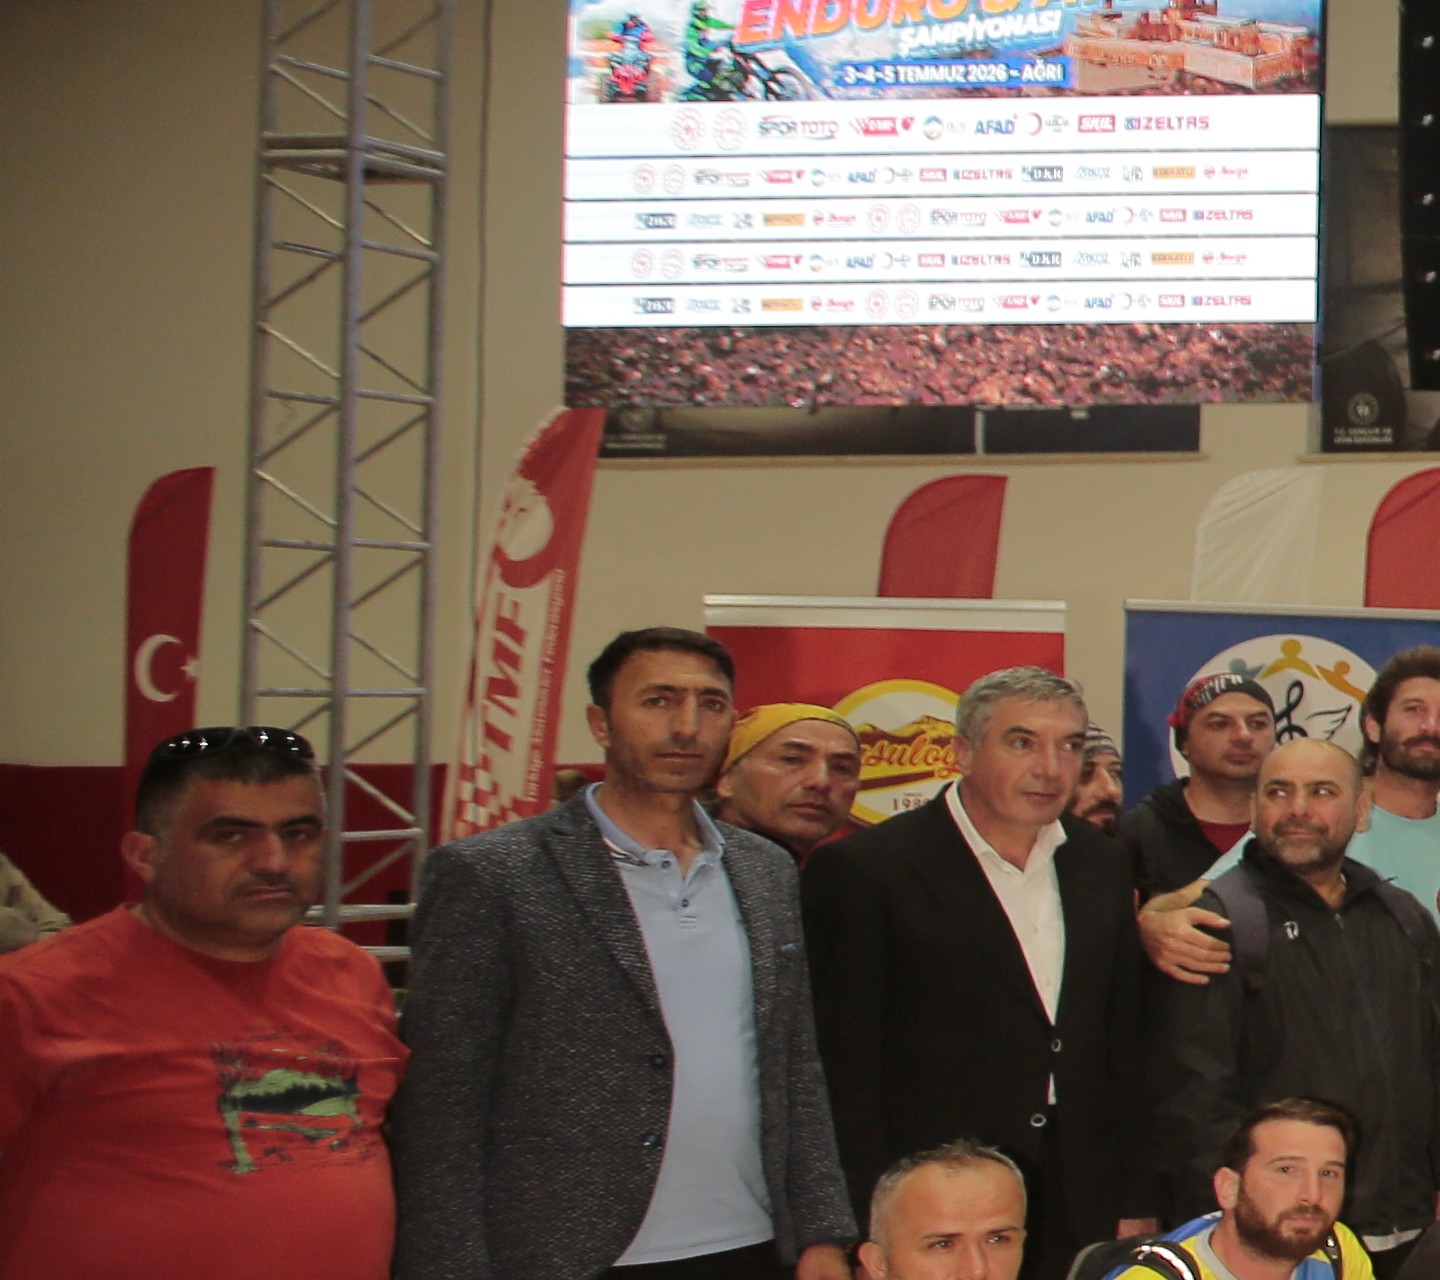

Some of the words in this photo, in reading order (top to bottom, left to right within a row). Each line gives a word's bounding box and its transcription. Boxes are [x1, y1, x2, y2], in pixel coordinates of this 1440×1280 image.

[899, 9, 1063, 54] ŞAMPİYONASI
[898, 63, 965, 83] TEMMUZ
[966, 63, 1007, 82] 2026
[1021, 58, 1065, 82] AĞRI
